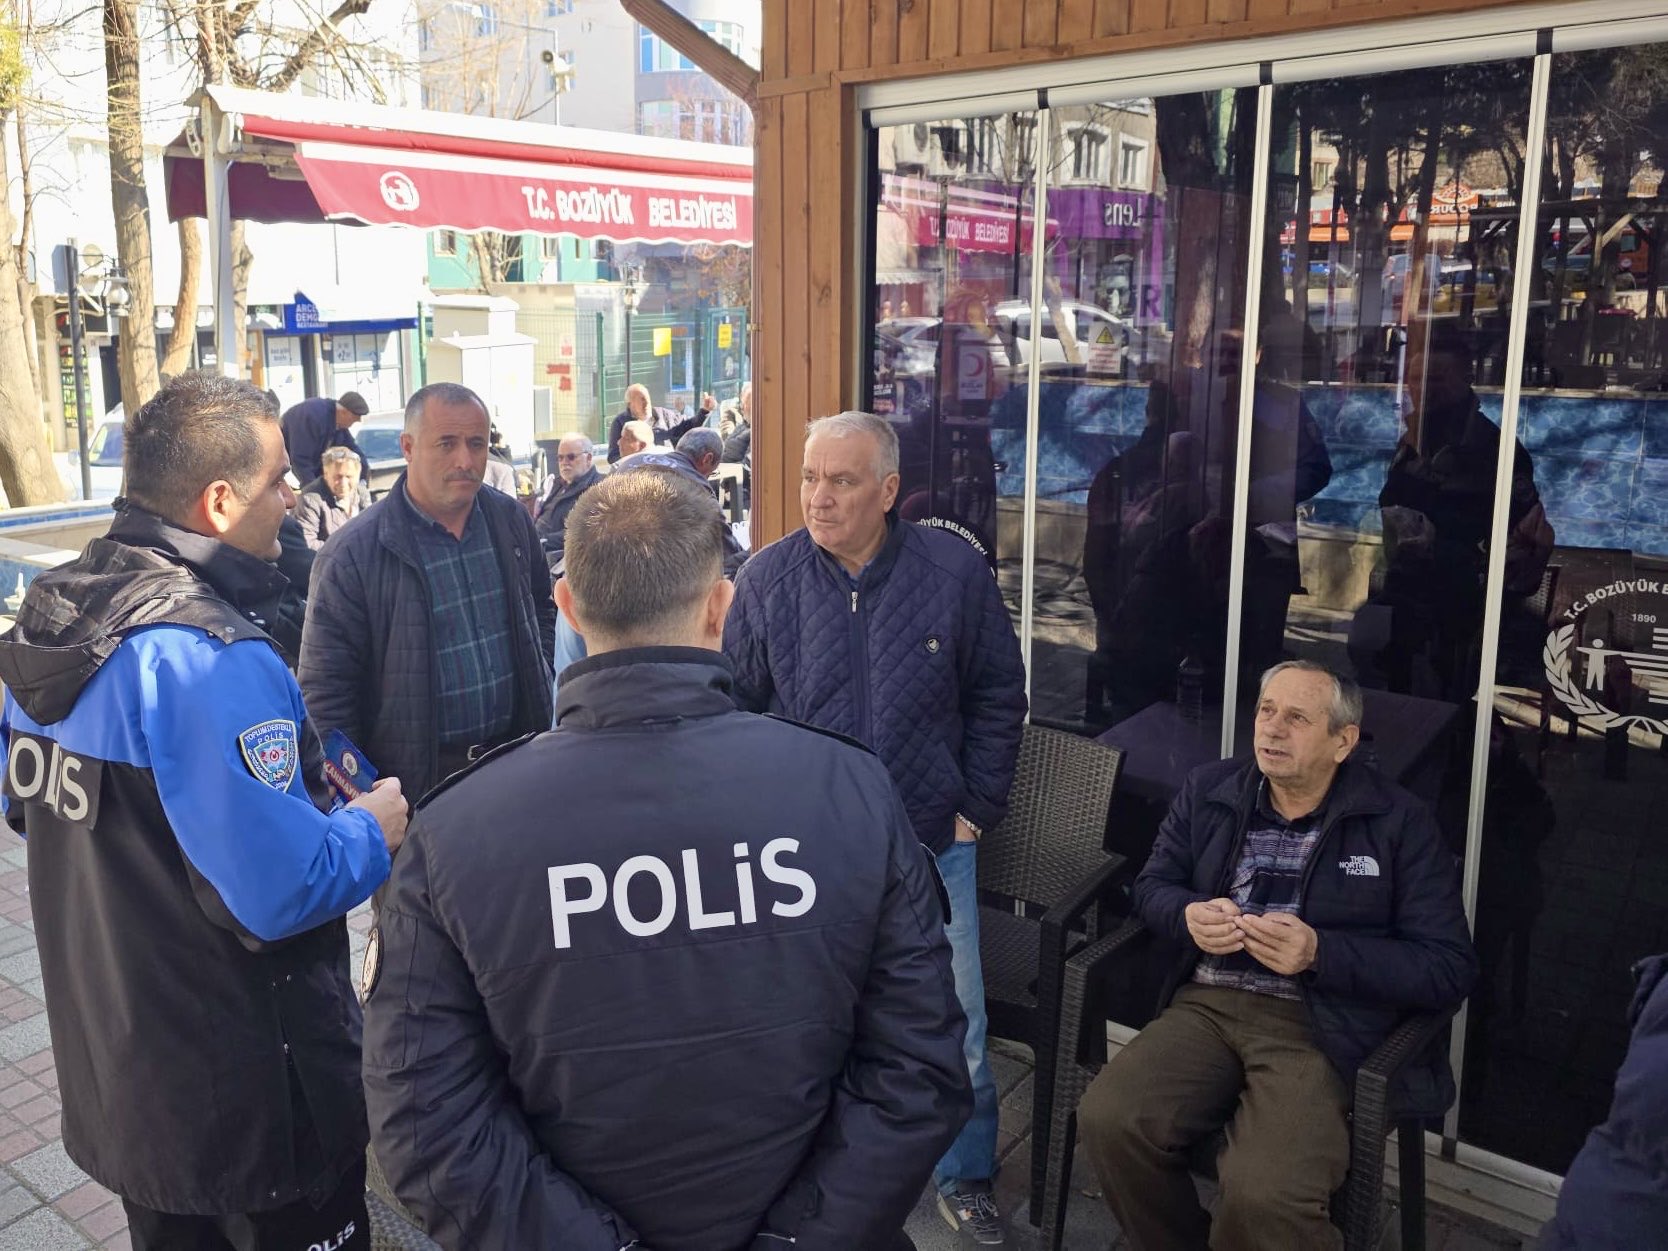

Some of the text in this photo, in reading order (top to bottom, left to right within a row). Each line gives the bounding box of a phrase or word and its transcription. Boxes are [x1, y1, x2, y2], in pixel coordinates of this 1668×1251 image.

[521, 186, 737, 230] T.C. BOZÜYÜK BELEDİYESİ
[1563, 601, 1588, 619] T.C.
[1585, 578, 1659, 604] BOZÜYÜK
[1632, 613, 1657, 623] 1890
[1349, 855, 1364, 863] THE
[1338, 861, 1365, 869] NORTH
[1346, 868, 1365, 876] FACE
